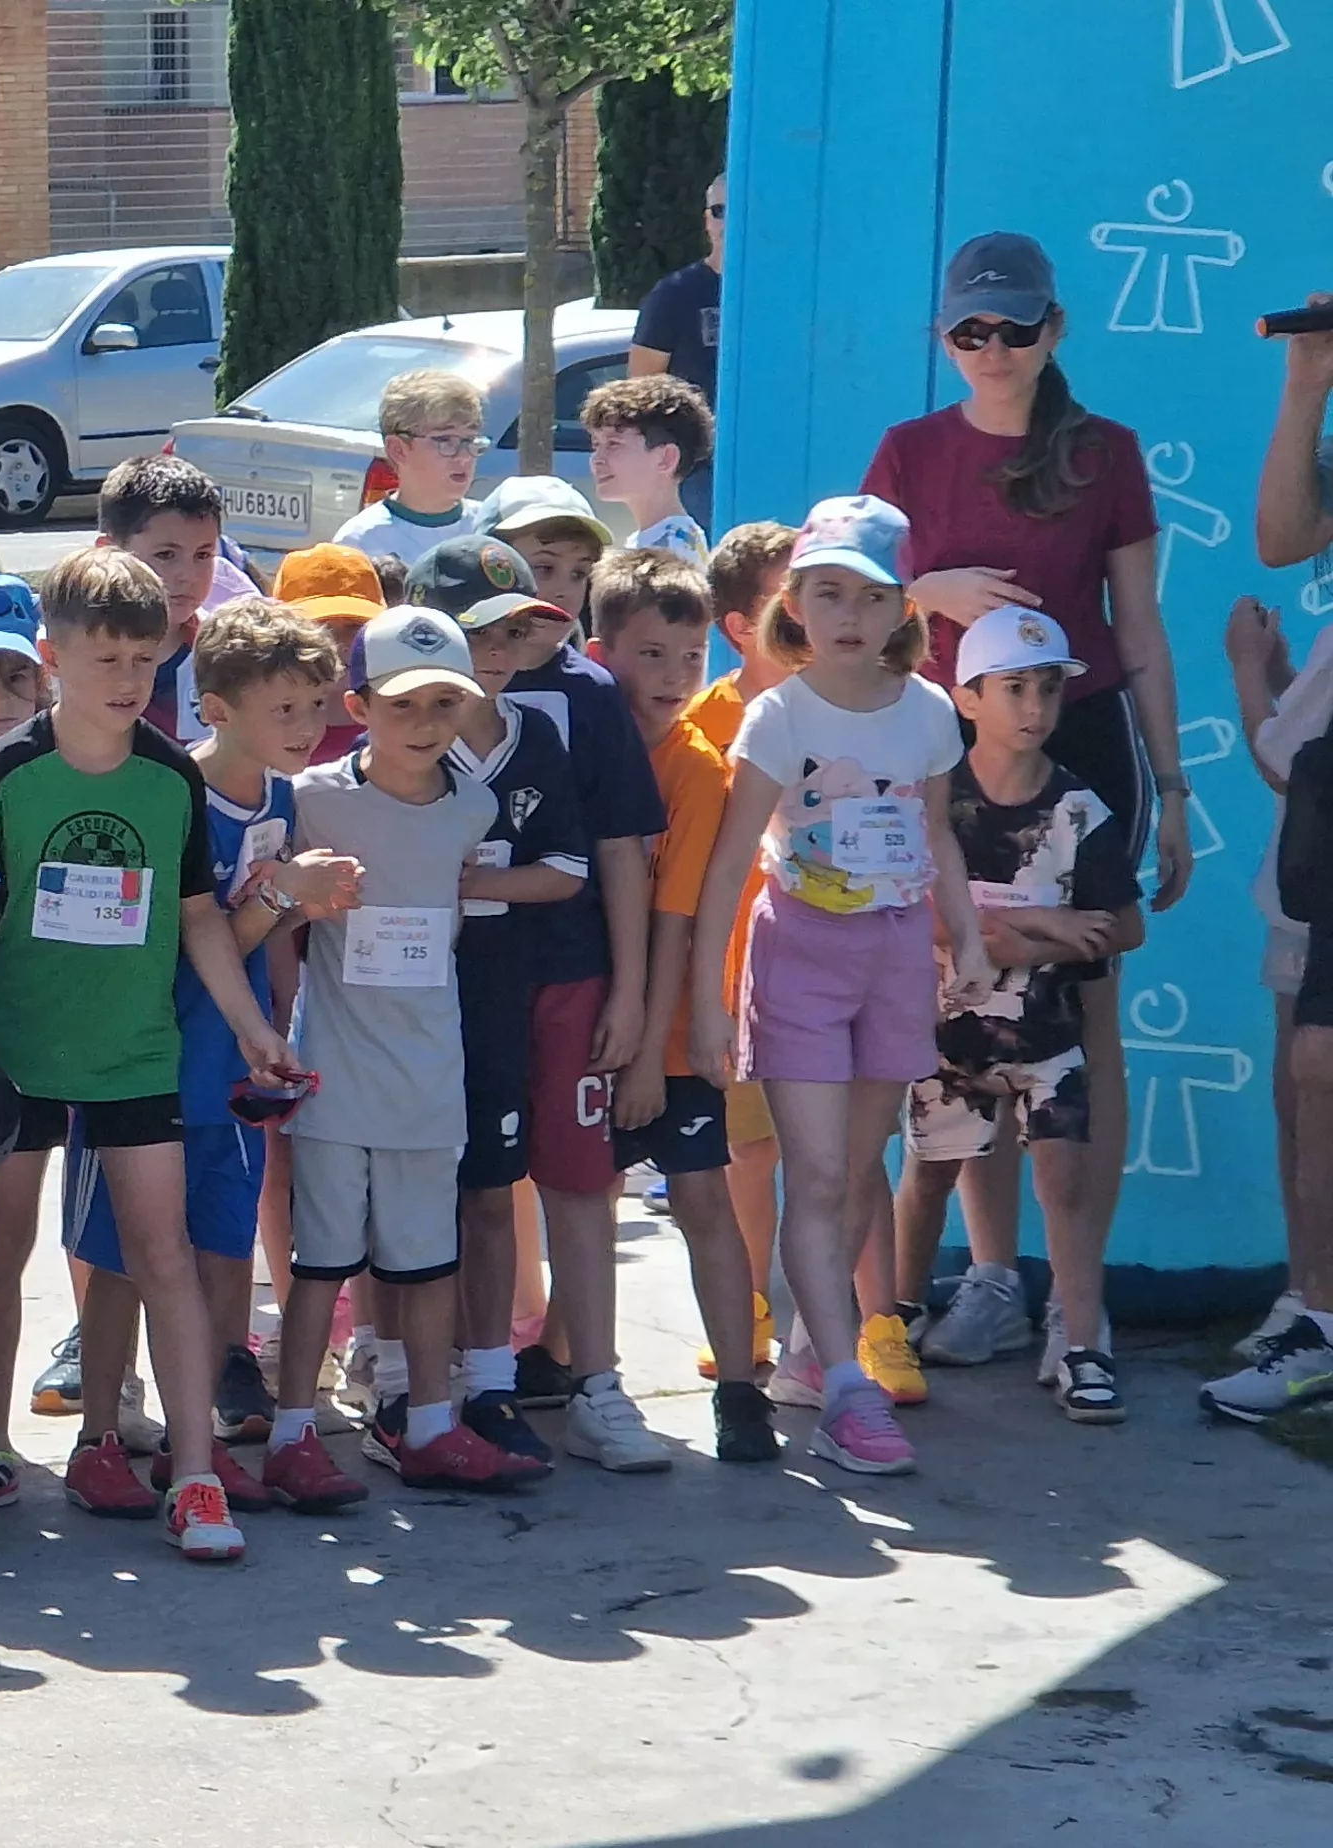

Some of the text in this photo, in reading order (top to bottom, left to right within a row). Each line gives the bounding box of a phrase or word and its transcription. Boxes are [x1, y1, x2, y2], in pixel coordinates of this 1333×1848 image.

[65, 817, 128, 837] ESCUELA
[94, 907, 122, 920] 135
[402, 946, 428, 960] 125
